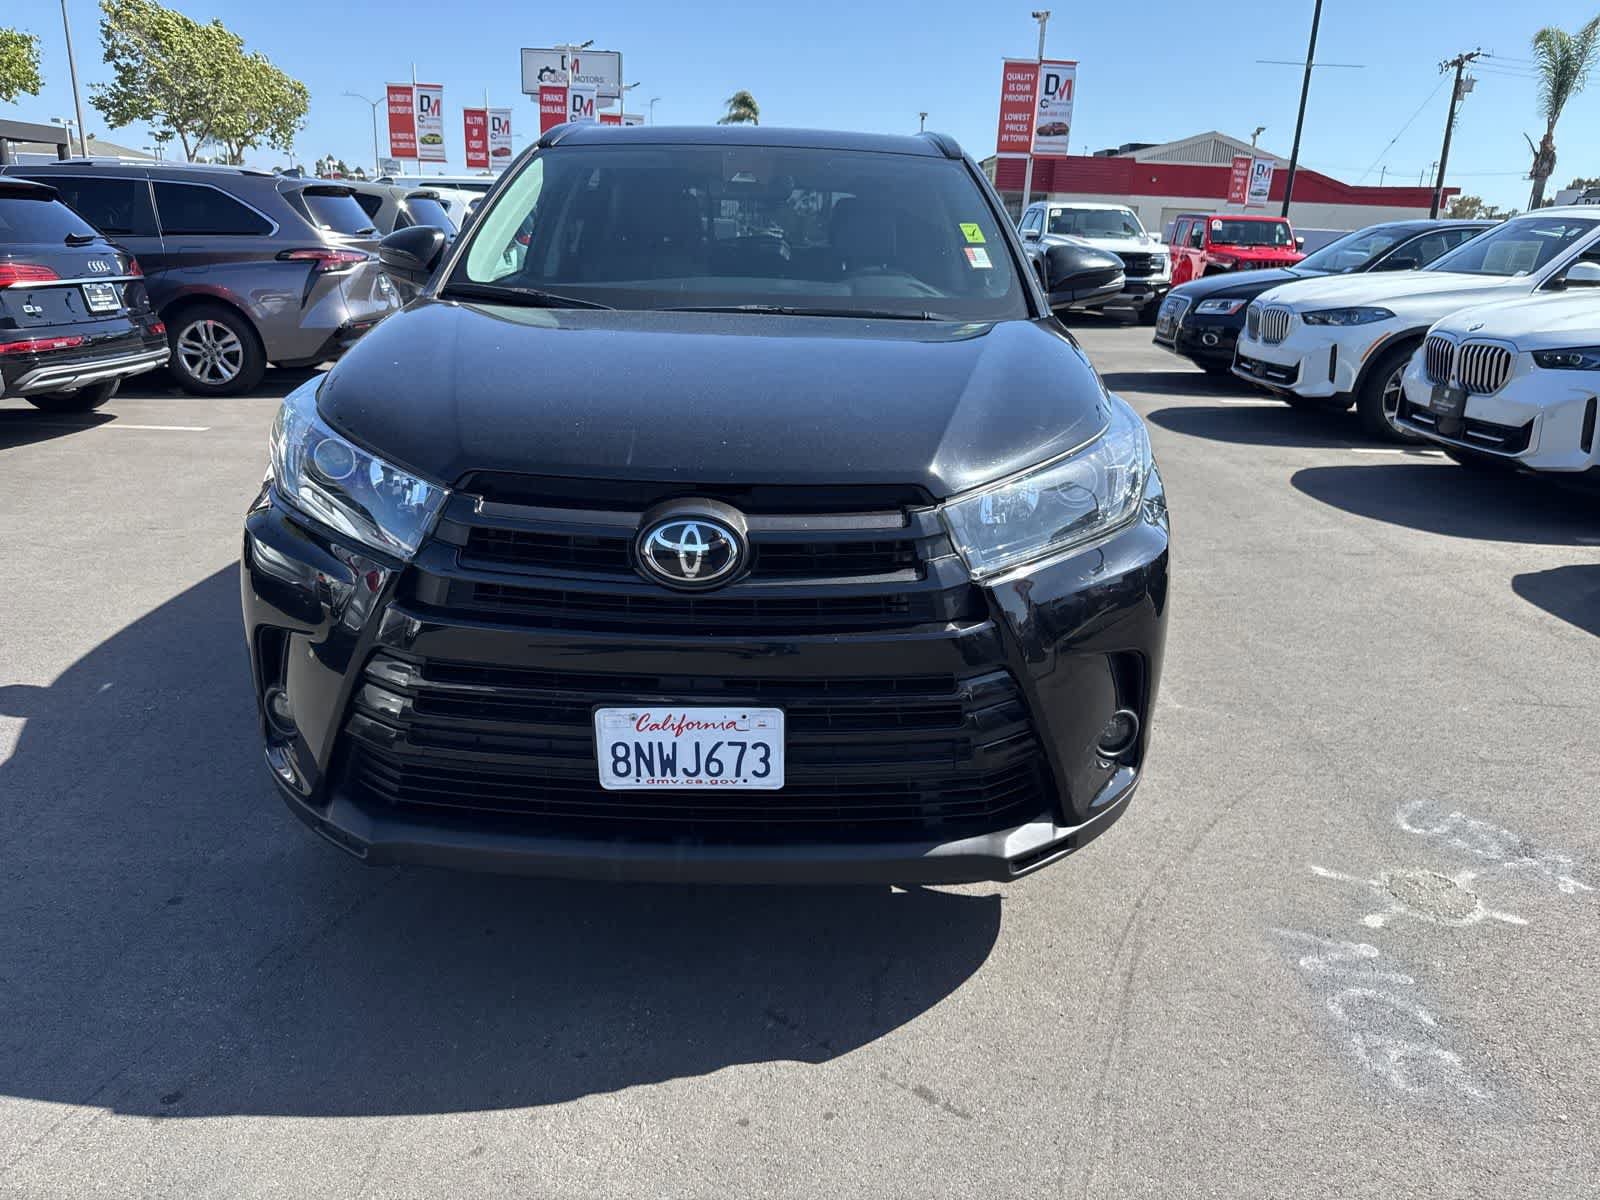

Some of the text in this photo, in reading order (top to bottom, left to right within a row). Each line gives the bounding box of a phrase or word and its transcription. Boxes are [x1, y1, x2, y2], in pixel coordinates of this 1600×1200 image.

[574, 75, 605, 84] MOTORS
[1006, 73, 1035, 81] QUALITY
[1008, 83, 1031, 92] IS OUR
[1004, 94, 1034, 103] PRIORITY
[1004, 113, 1031, 121] LOWEST
[1005, 124, 1028, 132] PRICES
[1001, 134, 1009, 142] IN
[635, 712, 750, 738] California
[610, 741, 771, 778] 8NWJ673
